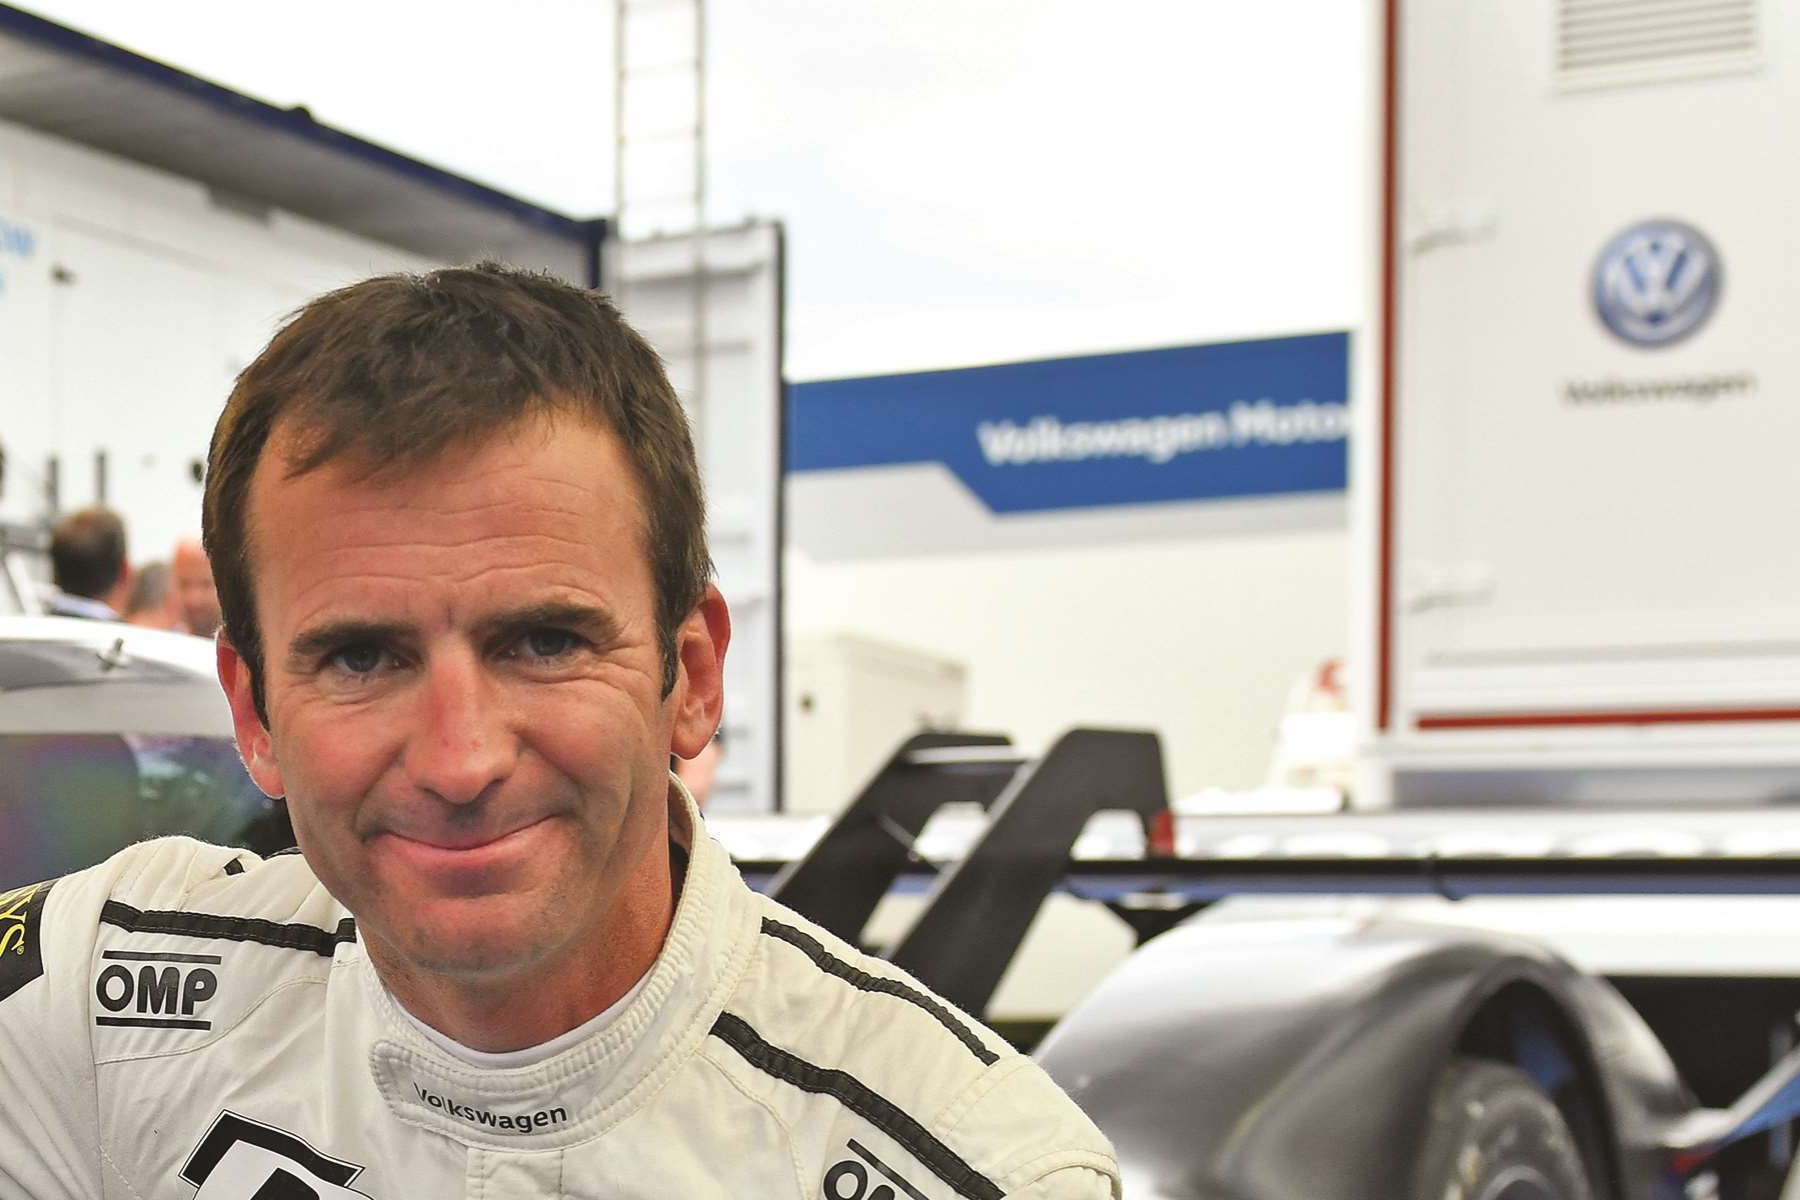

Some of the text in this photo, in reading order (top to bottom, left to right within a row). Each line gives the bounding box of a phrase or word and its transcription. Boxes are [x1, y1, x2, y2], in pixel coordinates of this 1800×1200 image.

[977, 416, 1227, 464] Volkswagen
[96, 965, 218, 1016] OMP
[413, 1081, 567, 1134] Volkswagen
